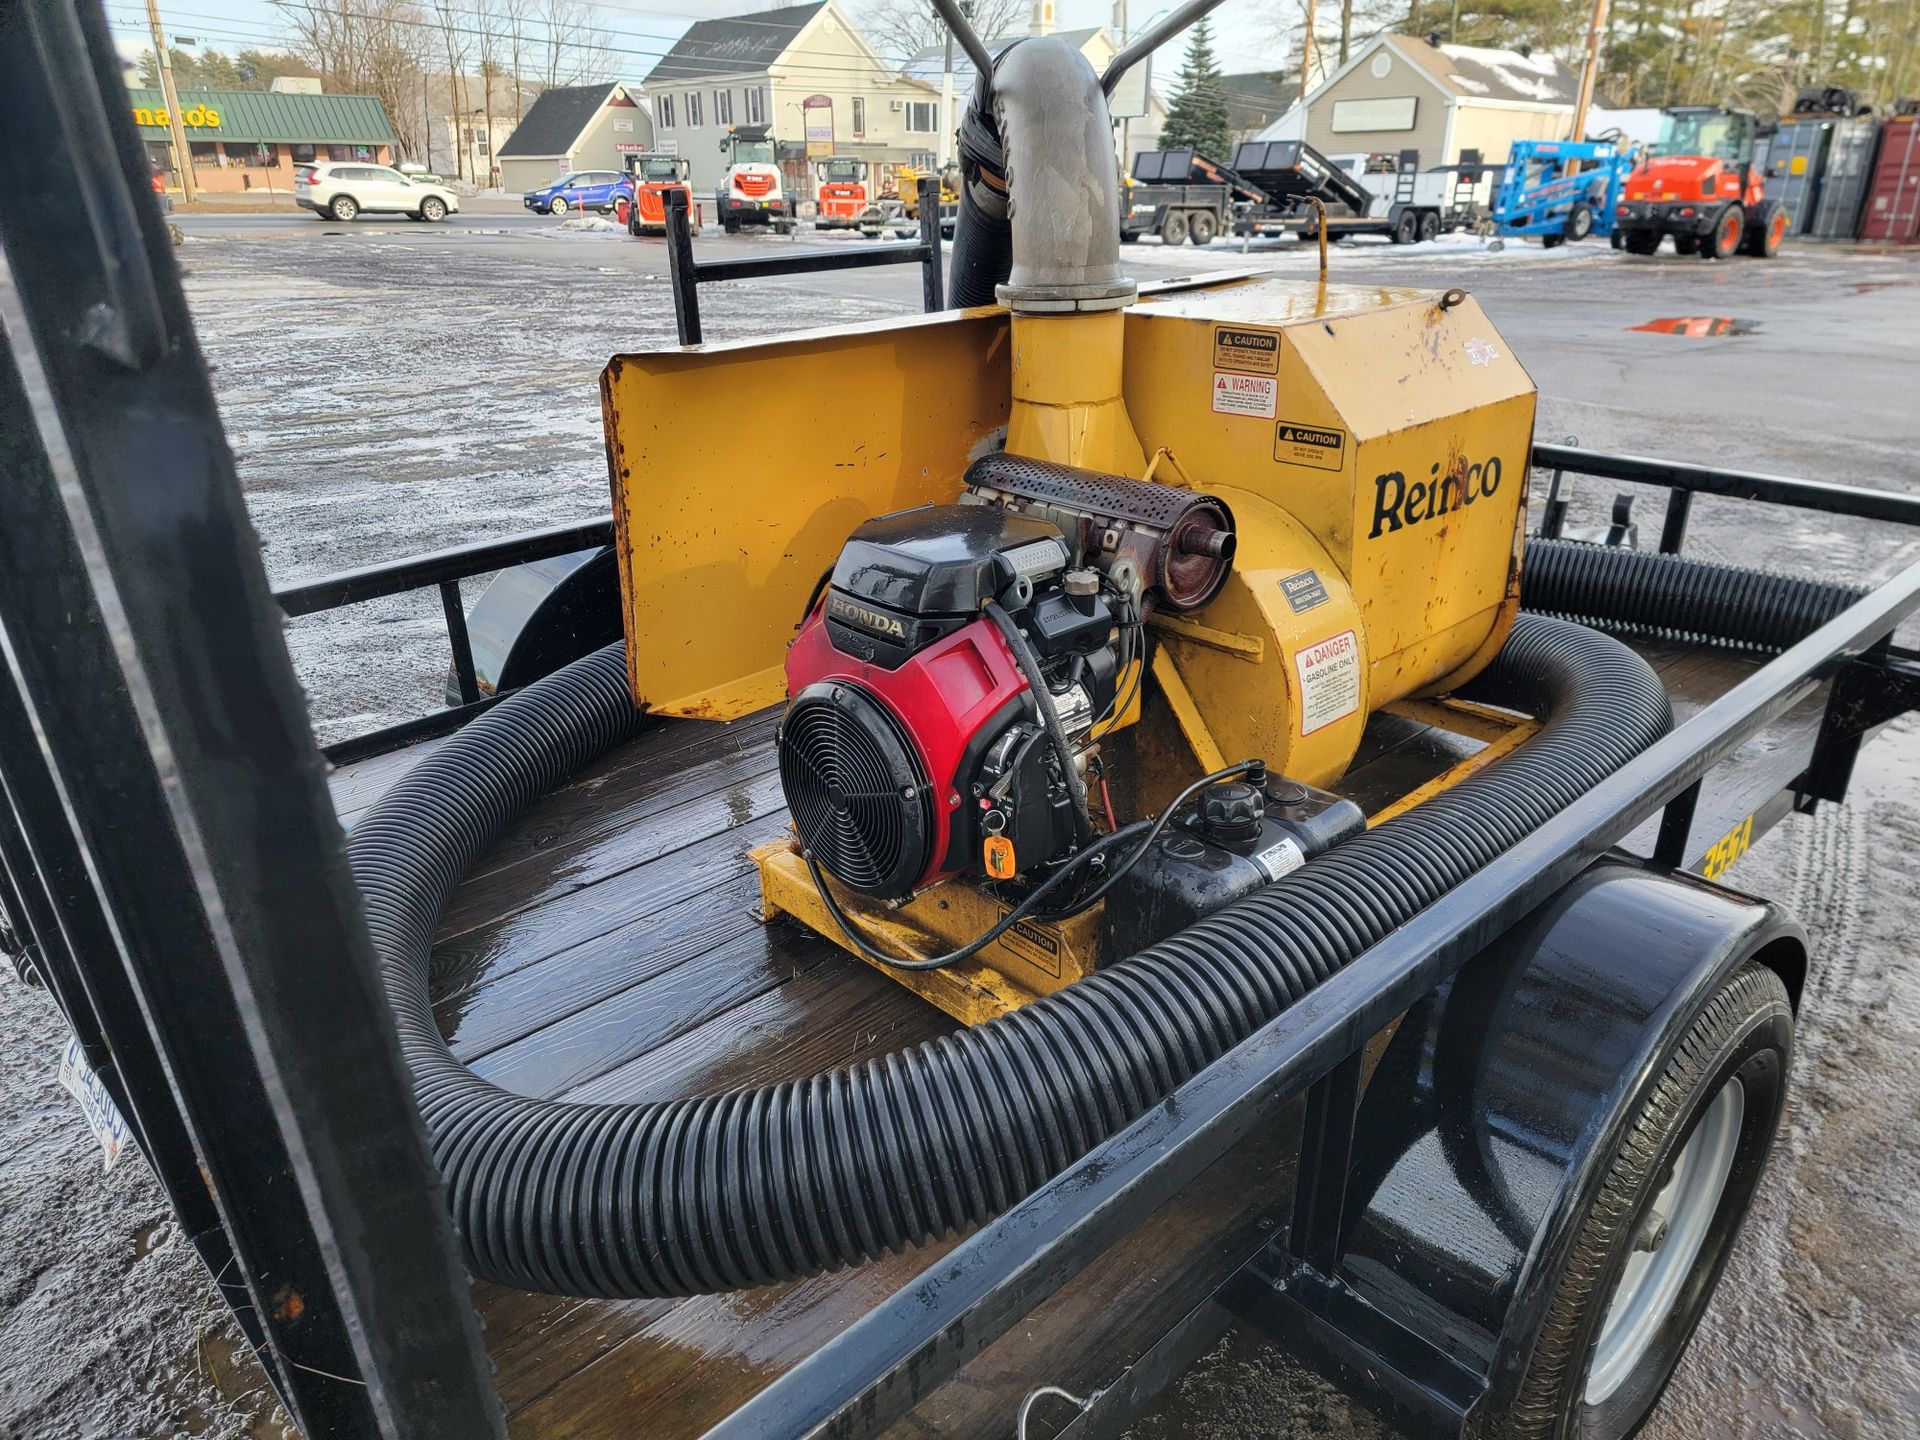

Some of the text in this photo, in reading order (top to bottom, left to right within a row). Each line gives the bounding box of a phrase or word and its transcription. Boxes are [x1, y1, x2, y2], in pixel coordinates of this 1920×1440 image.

[1234, 335, 1273, 348] CAUTION
[1232, 378, 1271, 394] WARNING
[1296, 432, 1337, 445] CAUTION
[1368, 455, 1502, 540] Reinco
[1286, 577, 1314, 592] Reinco
[831, 598, 906, 639] HONDA
[1314, 637, 1351, 664] DANGER
[1306, 655, 1356, 683] GASOLINE ONLY
[1016, 923, 1053, 951] CAUTION
